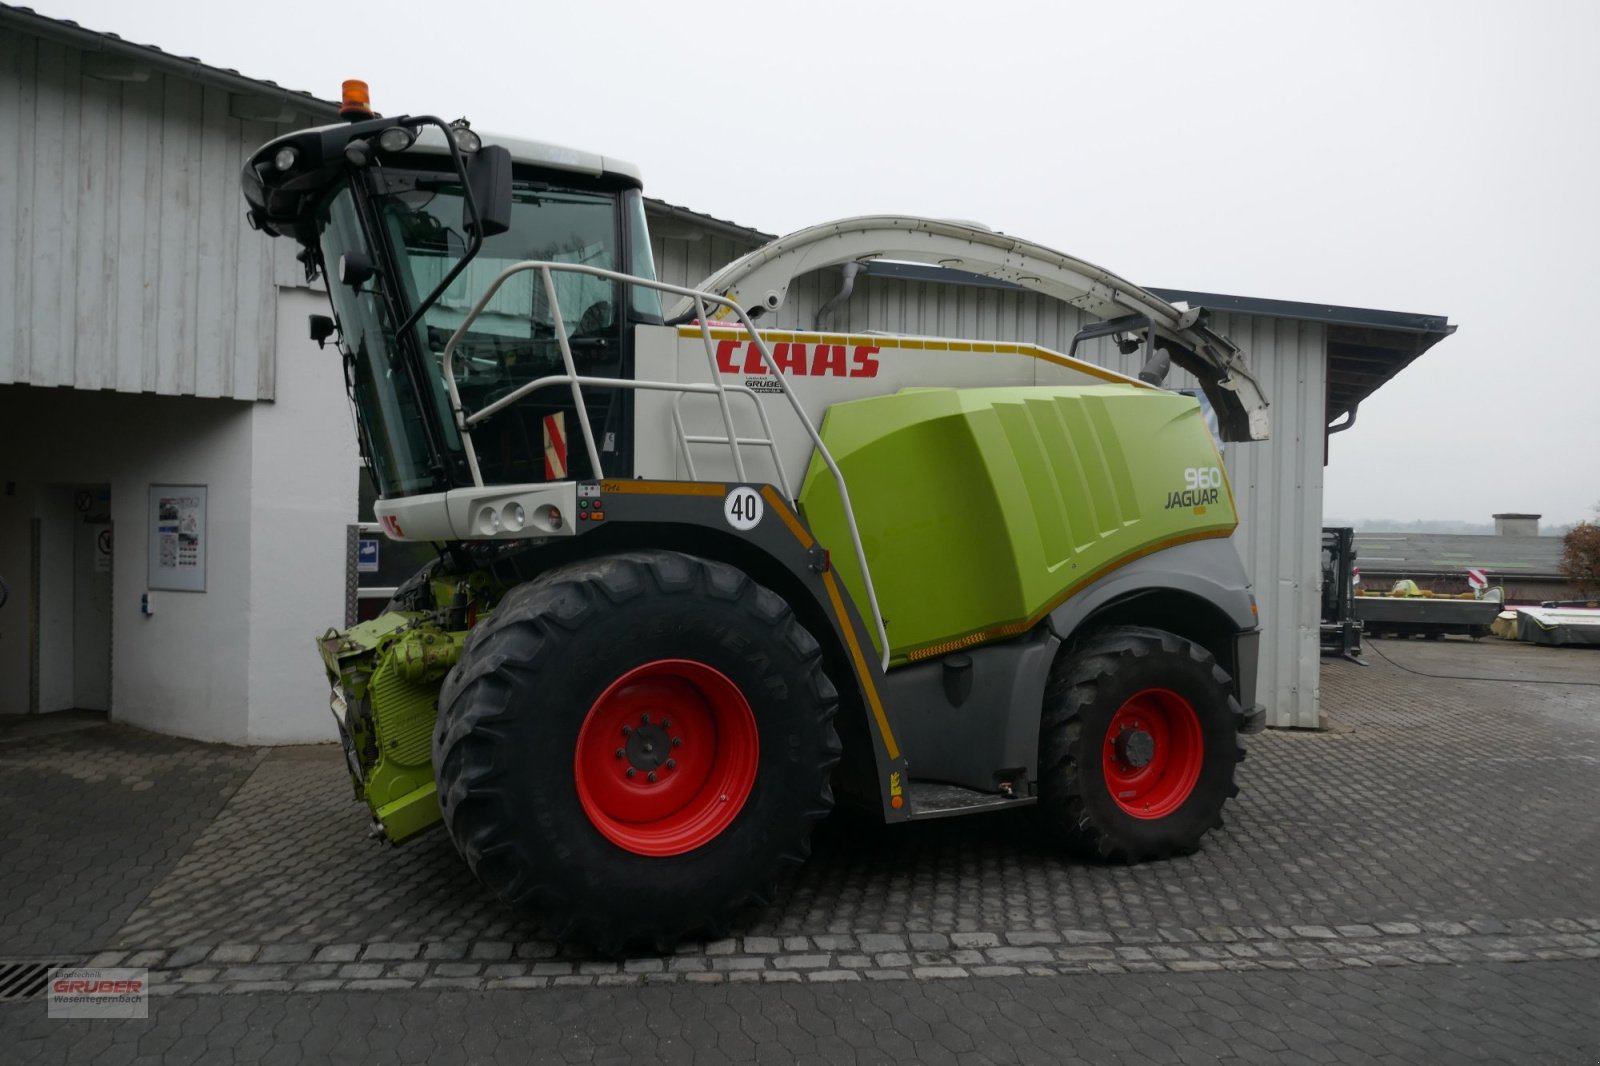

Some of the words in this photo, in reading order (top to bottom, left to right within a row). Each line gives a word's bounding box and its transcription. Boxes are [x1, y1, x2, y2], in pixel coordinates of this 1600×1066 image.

[716, 340, 880, 378] CLAAS
[1184, 467, 1221, 490] 960
[731, 494, 756, 521] 40
[1164, 488, 1218, 509] JAGUAR
